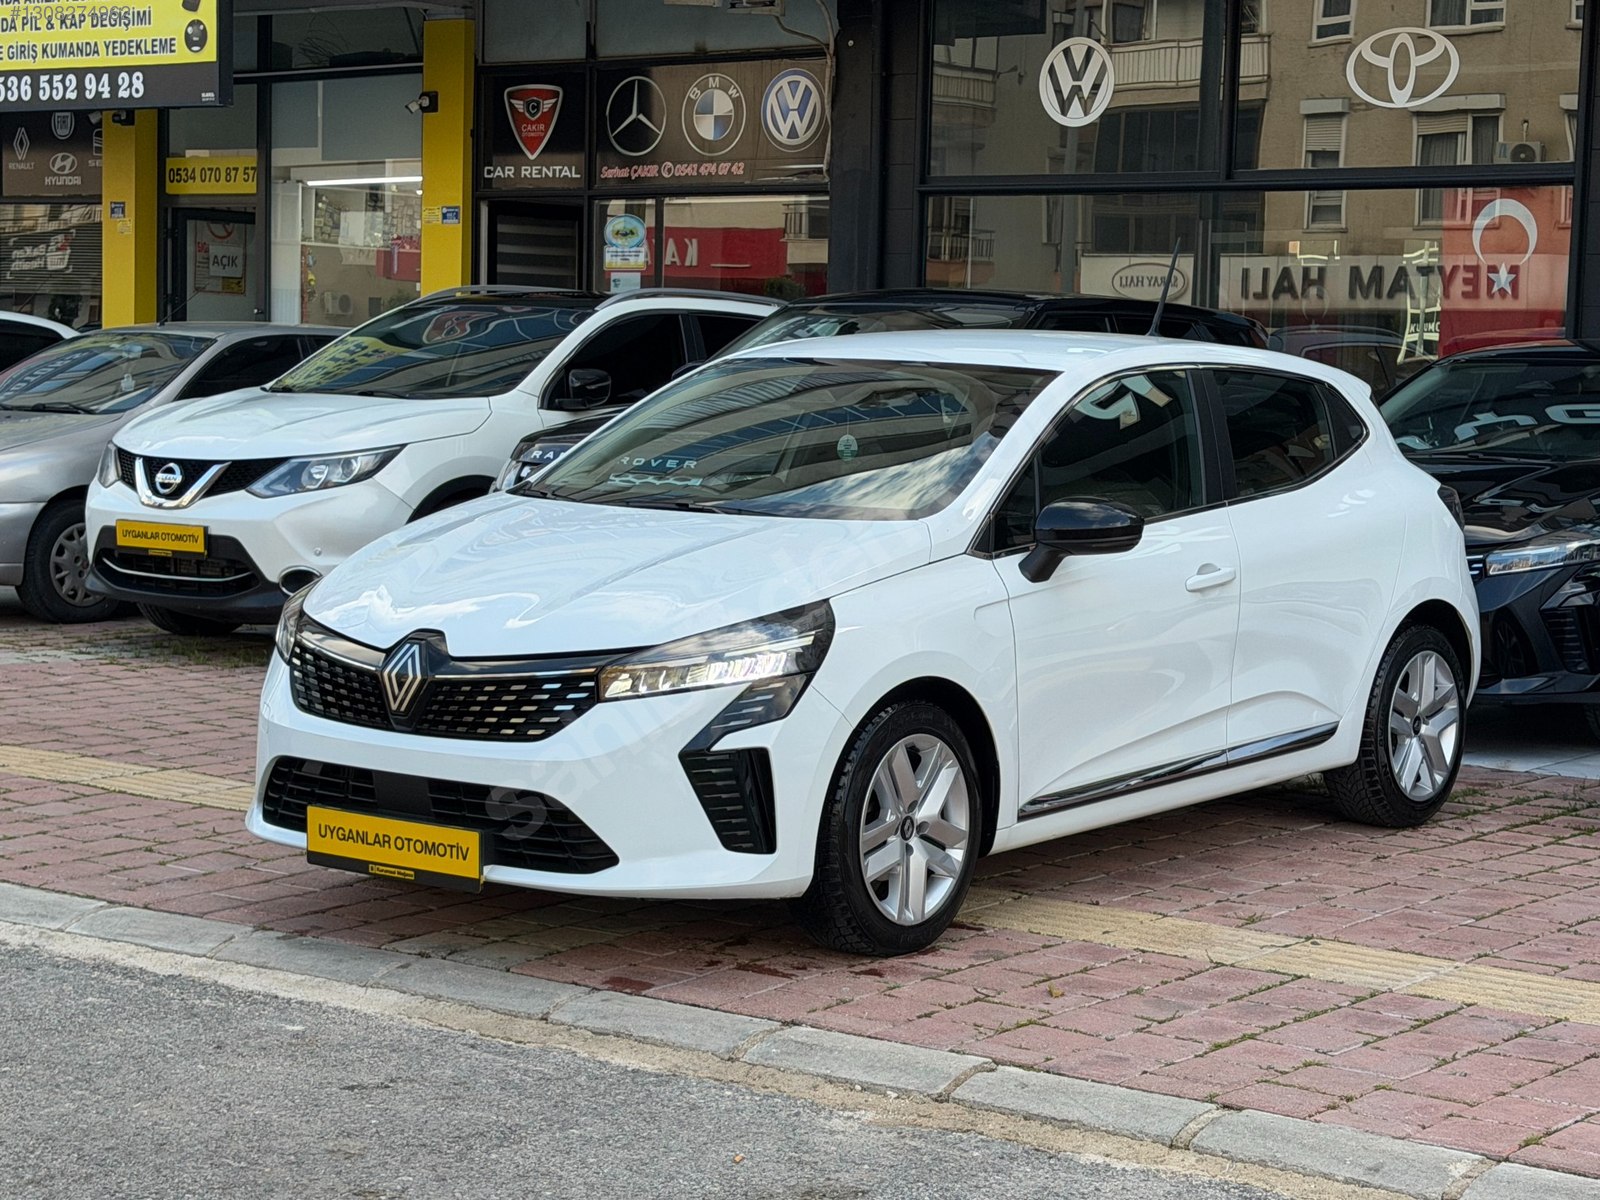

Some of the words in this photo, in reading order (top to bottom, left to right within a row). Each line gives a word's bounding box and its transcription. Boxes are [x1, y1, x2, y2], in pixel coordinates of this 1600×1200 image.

[22, 12, 41, 31] PİL
[46, 15, 55, 30] &
[60, 14, 86, 29] KAP
[7, 41, 38, 63] GİRİŞ
[41, 41, 100, 59] KUMANDA
[103, 37, 176, 56] YEDEKLEME
[39, 74, 77, 101] 552
[84, 72, 111, 99] 94
[118, 71, 144, 98] 28
[8, 162, 35, 170] RENAULT
[484, 166, 515, 178] CAR
[521, 166, 581, 178] RENTAL
[44, 176, 82, 186] HYUNDAI
[168, 168, 196, 183] 0534
[200, 167, 221, 183] 070
[224, 167, 239, 183] 87
[242, 166, 257, 183] 57
[212, 255, 238, 270] AÇIK
[617, 456, 697, 469] ROVER
[122, 529, 160, 541] UYGANLAR
[160, 531, 199, 544] OTOMOTİV
[318, 823, 391, 849] UYGANLAR
[394, 836, 469, 861] OTOMOTİV
